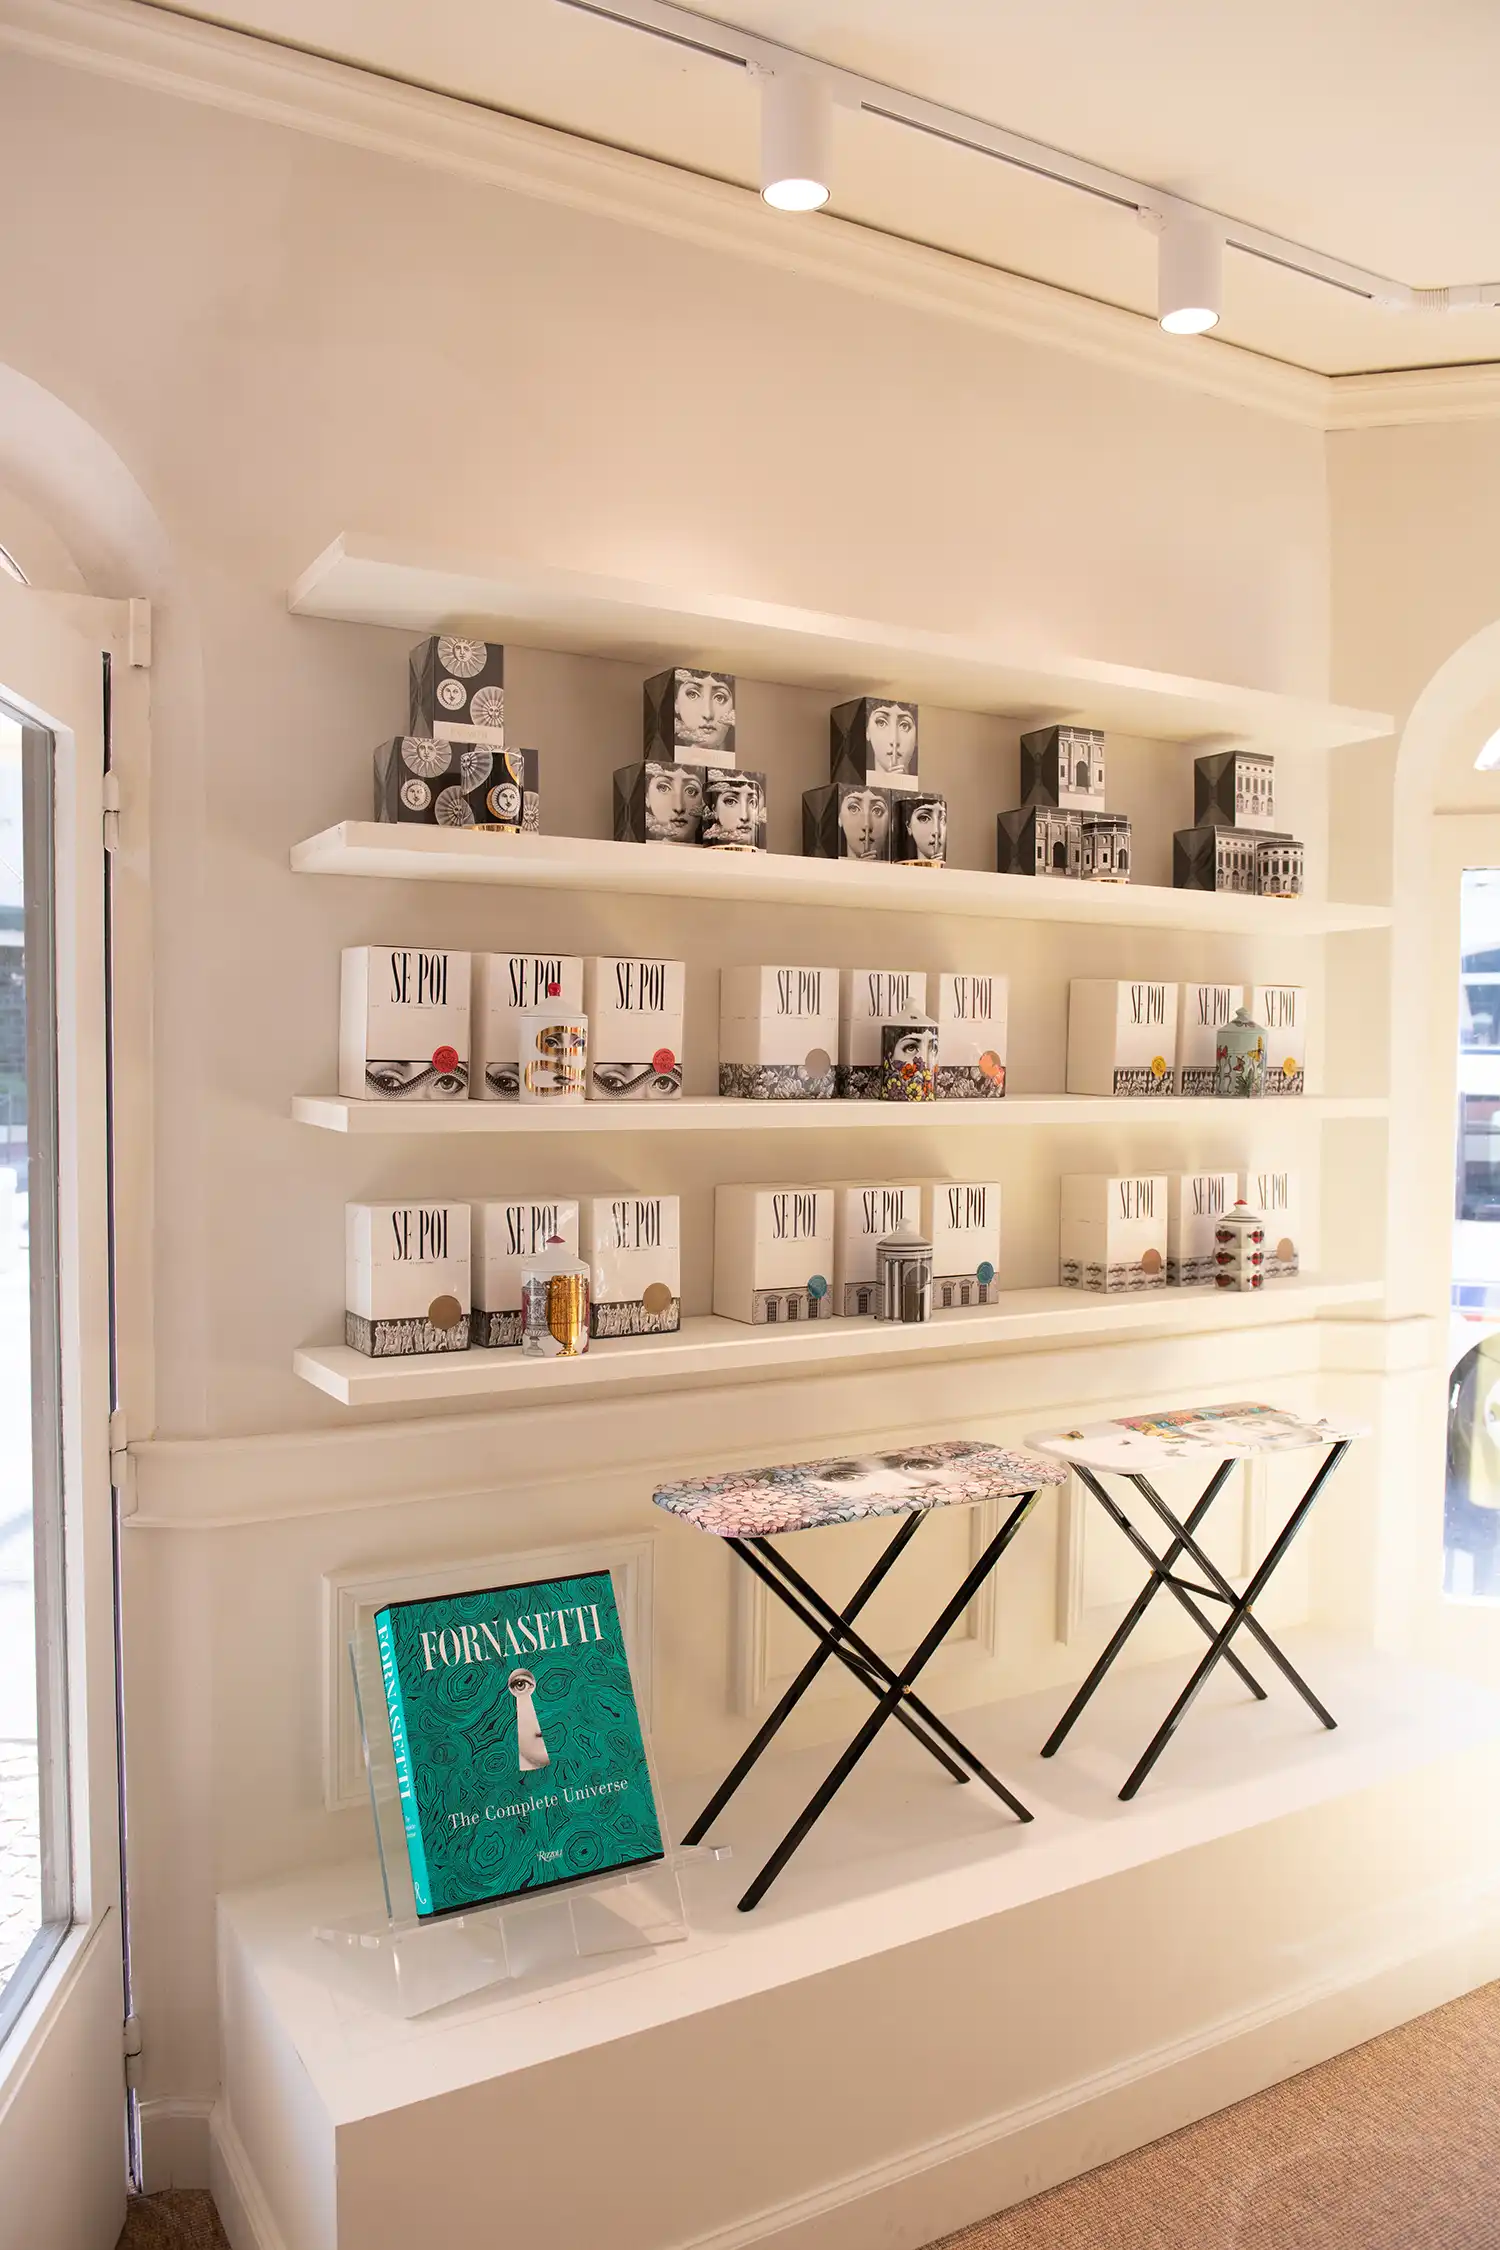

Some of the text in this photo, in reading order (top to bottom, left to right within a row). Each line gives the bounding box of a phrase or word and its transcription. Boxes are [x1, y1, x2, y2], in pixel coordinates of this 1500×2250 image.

[390, 952, 449, 1006] SE POI
[508, 957, 528, 1008] SE
[615, 961, 666, 1012] SE POI
[777, 969, 822, 1016] SE POI
[868, 973, 883, 1017] SE
[953, 976, 993, 1020] SE POI
[1131, 985, 1166, 1025] SE POI
[1198, 987, 1230, 1026] SE POI
[1264, 990, 1295, 1028] SE POI
[862, 1190, 905, 1234] SE POI
[948, 1186, 987, 1229] SE POI
[1120, 1179, 1155, 1220] SE POI
[1192, 1176, 1225, 1215] SE POI
[1272, 1173, 1288, 1210] POI
[392, 1209, 449, 1261] SE POI
[506, 1206, 526, 1256] SE
[612, 1200, 661, 1249] SE POI
[772, 1193, 818, 1239] SE POI
[419, 1604, 605, 1671] FORNASETTI
[448, 1778, 629, 1830] The Complete Universe
